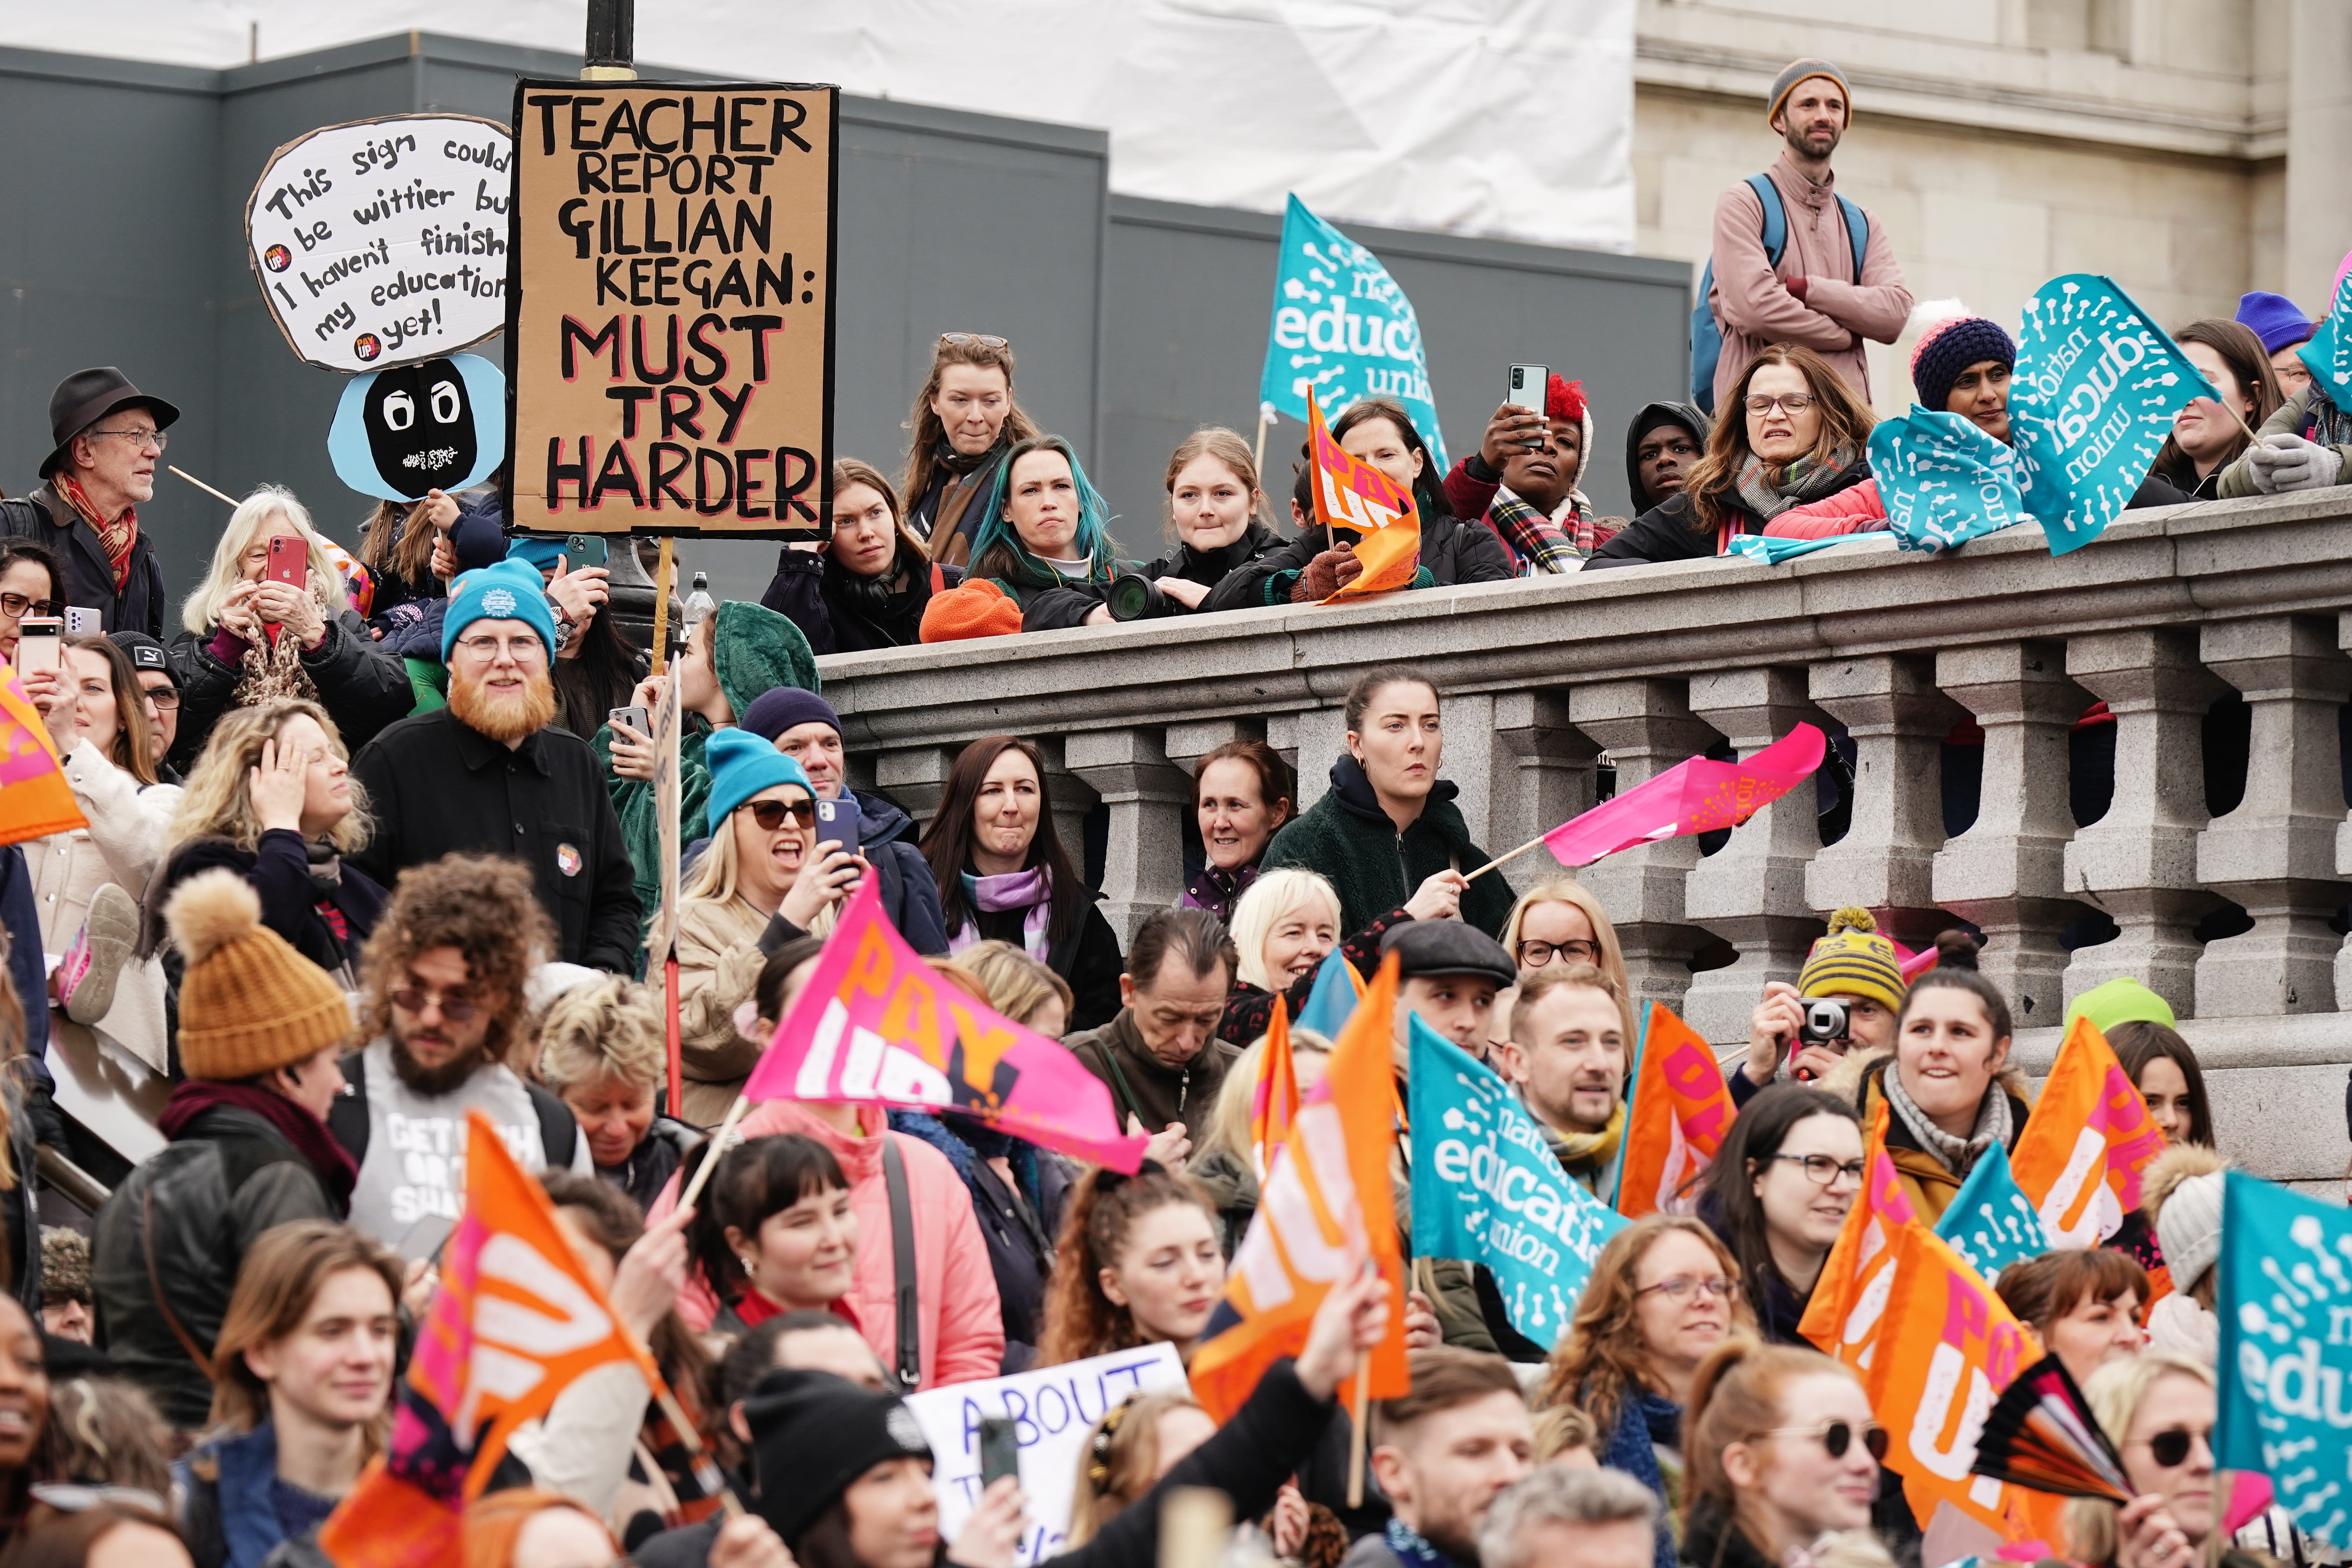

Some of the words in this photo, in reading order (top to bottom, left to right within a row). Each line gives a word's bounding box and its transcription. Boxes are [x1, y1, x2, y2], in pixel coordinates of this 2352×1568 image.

[528, 95, 812, 155] TEACHER
[265, 169, 332, 220] This
[352, 135, 416, 175] sign
[444, 140, 512, 173] could
[578, 152, 774, 195] REPORT
[294, 221, 332, 251] be
[353, 179, 455, 225] wittier
[476, 179, 509, 214] bu
[559, 196, 771, 259] GILLIAN
[266, 246, 282, 260] PAY
[274, 282, 297, 310] I
[300, 238, 389, 297] haven't
[421, 222, 508, 256] finish
[597, 253, 815, 309] KEEGAN:
[316, 302, 356, 341] my
[356, 336, 374, 347] PAY
[382, 298, 442, 350] yet!
[561, 314, 784, 386] MUST
[606, 383, 757, 445] TRY
[548, 435, 819, 523] HARDER
[386, 1112, 452, 1154] GET
